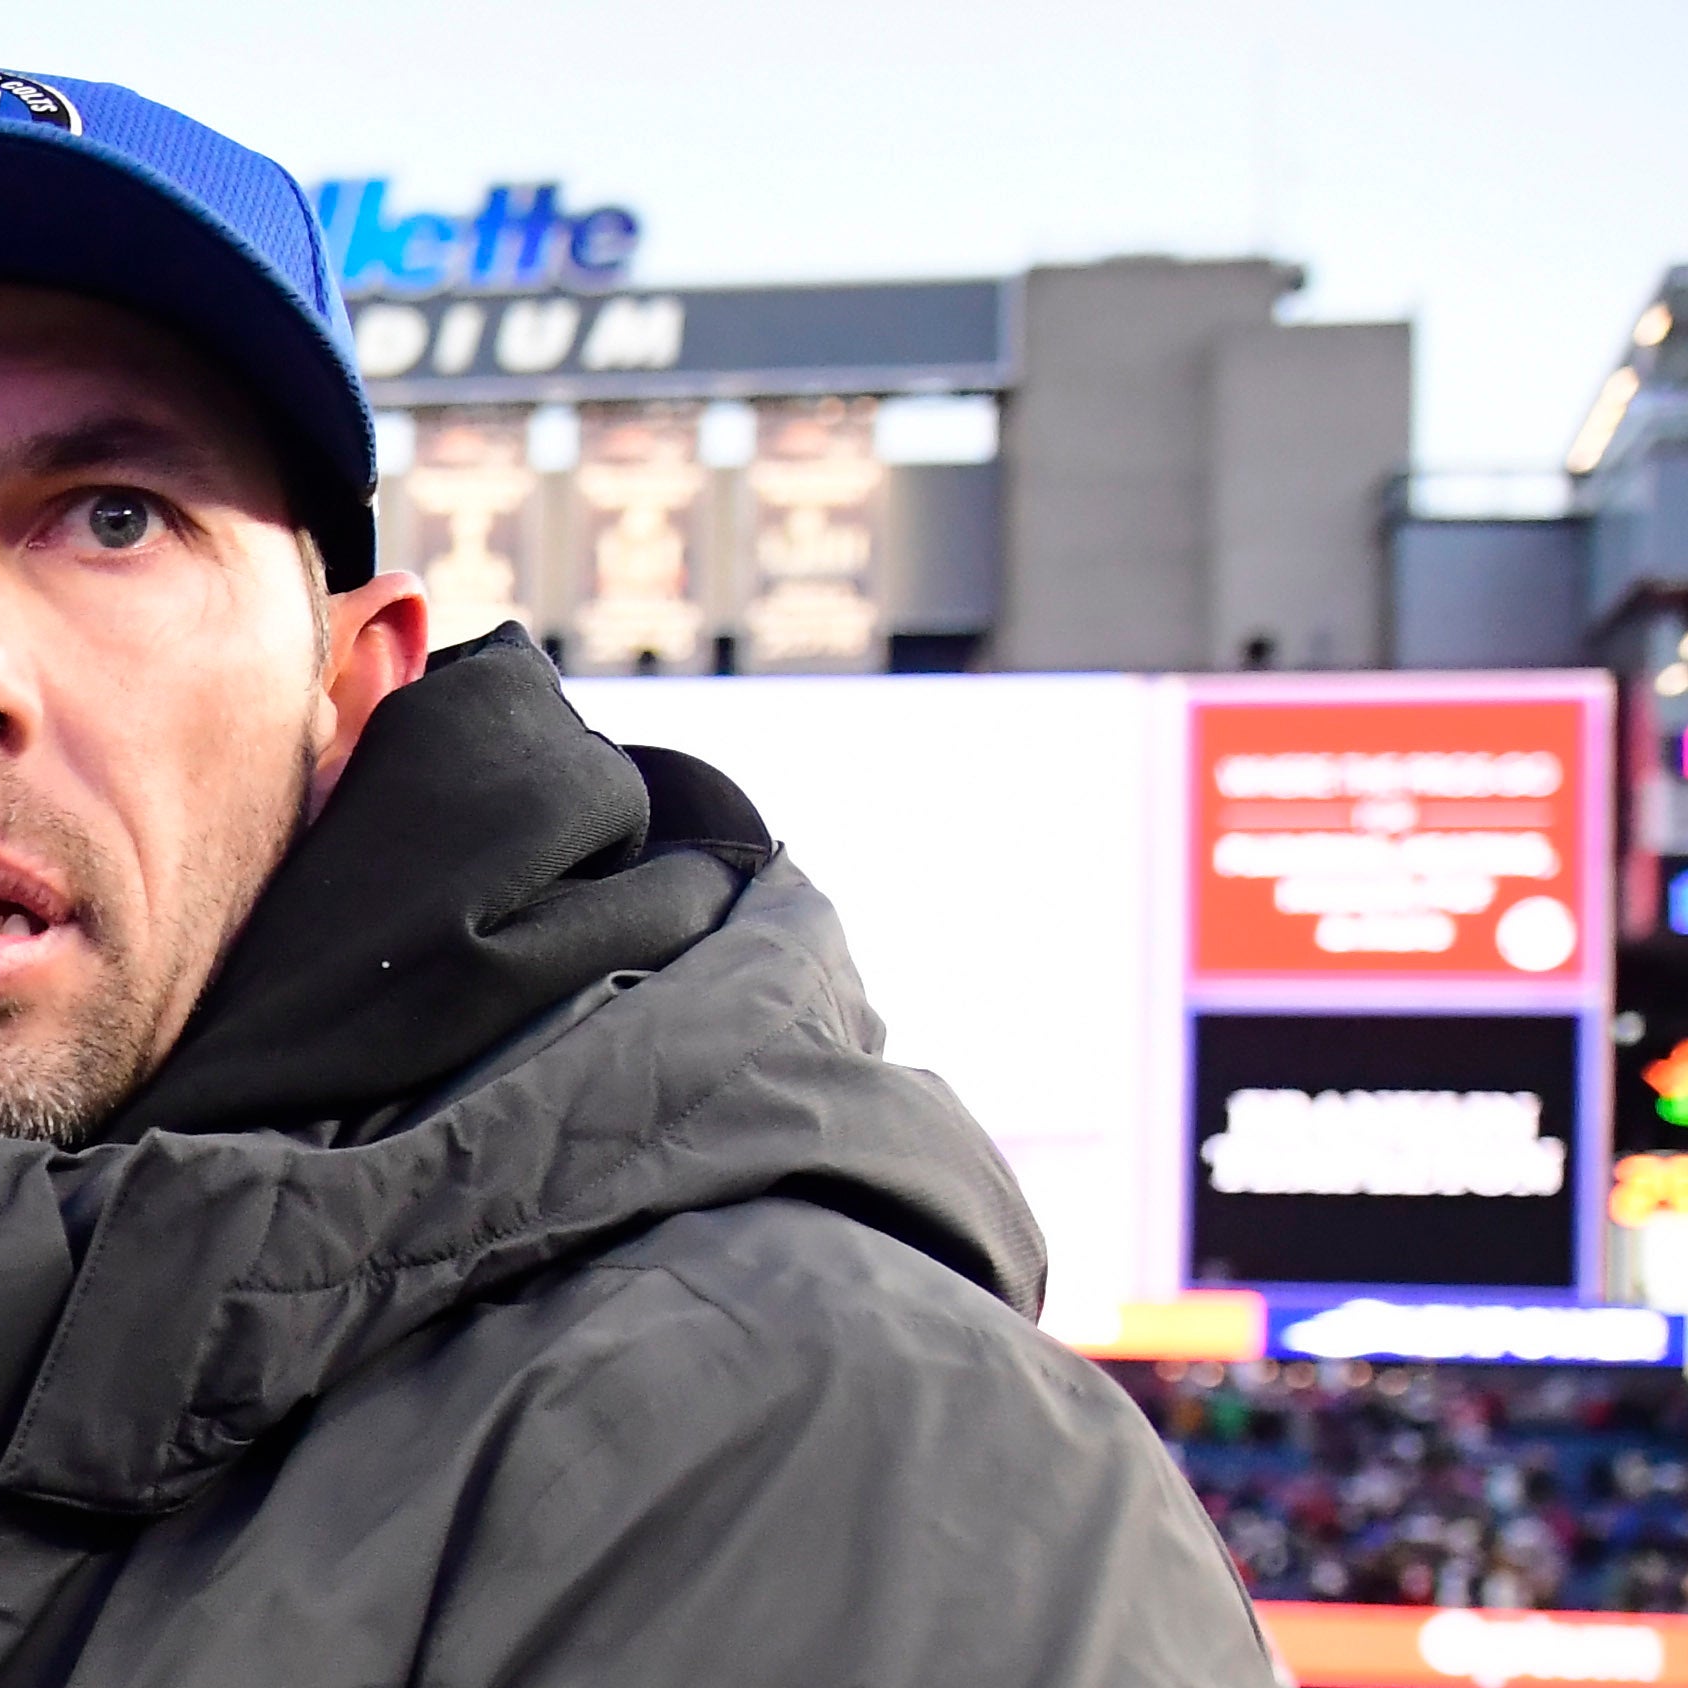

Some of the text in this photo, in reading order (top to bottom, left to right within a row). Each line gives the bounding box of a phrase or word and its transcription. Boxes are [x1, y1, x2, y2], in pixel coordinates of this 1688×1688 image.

[0, 81, 58, 112] COLTS
[319, 179, 638, 286] llette
[354, 302, 686, 378] DIUM
